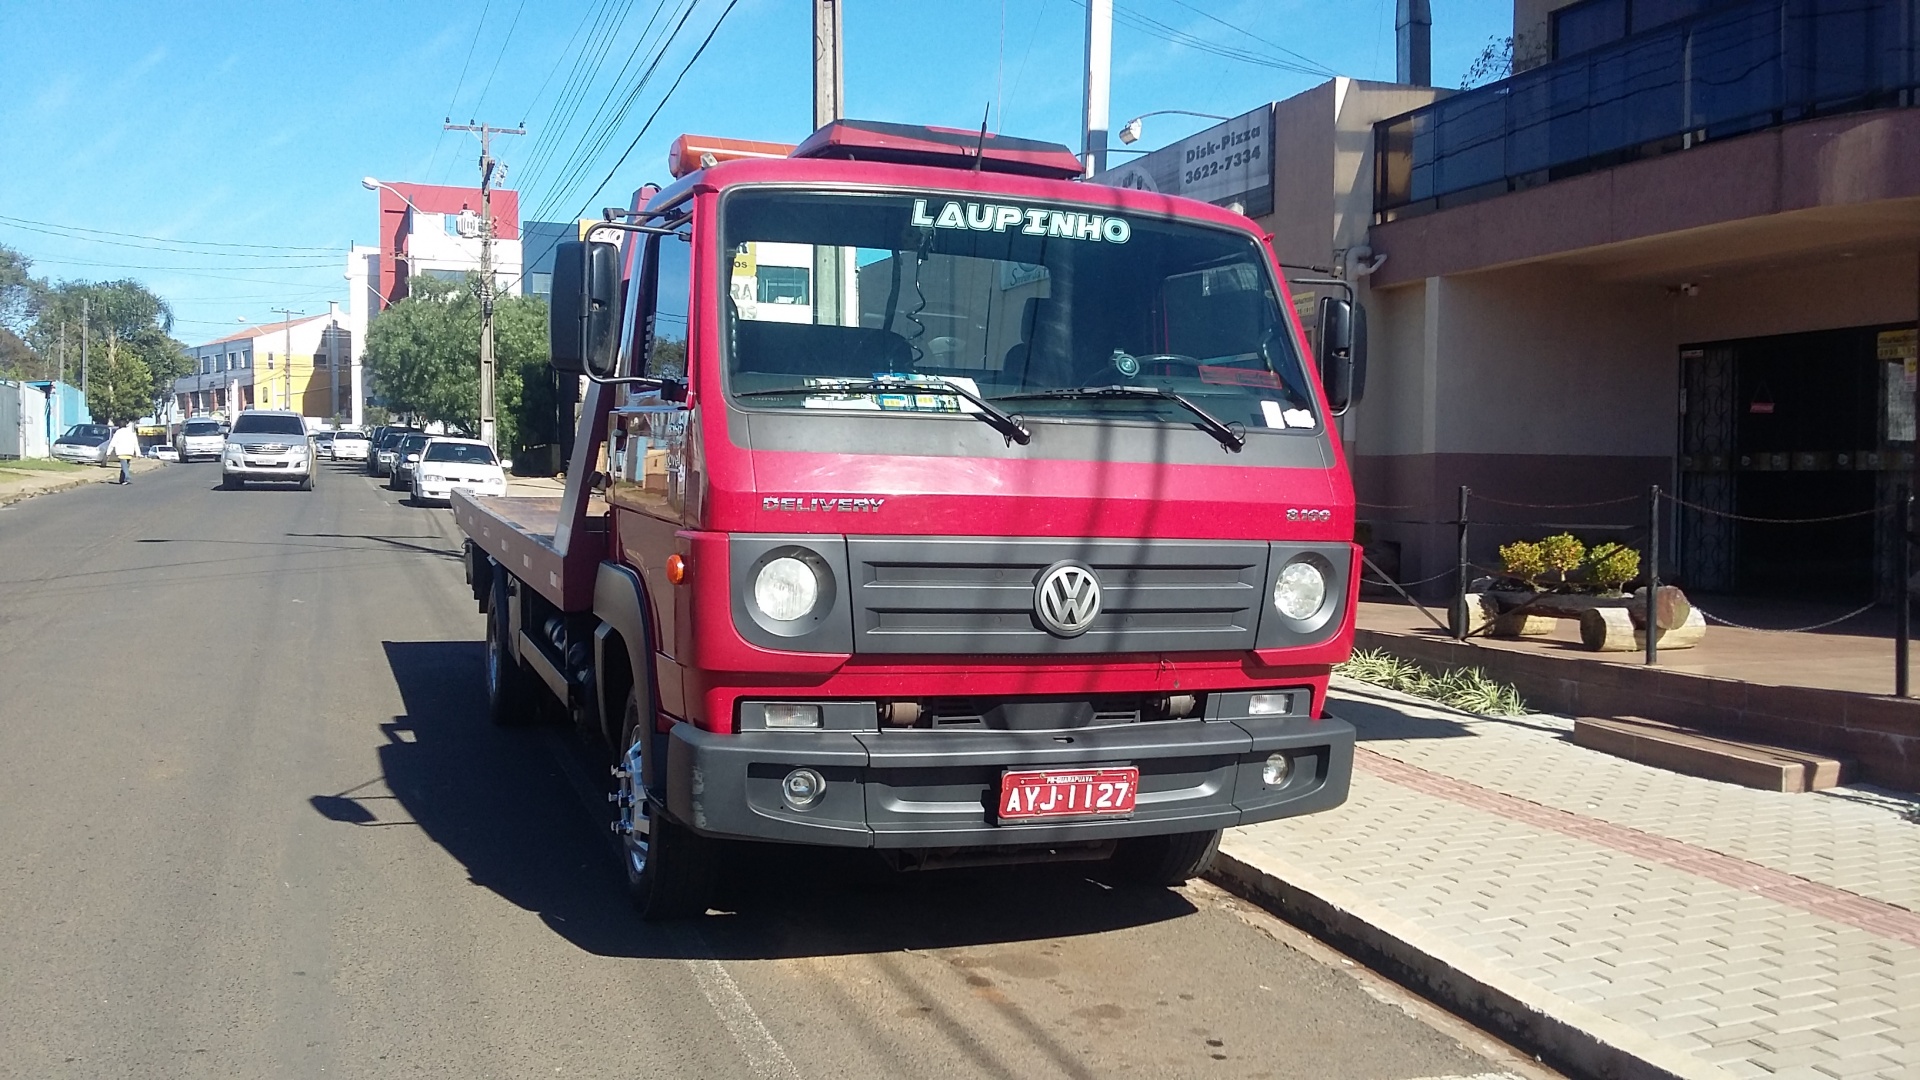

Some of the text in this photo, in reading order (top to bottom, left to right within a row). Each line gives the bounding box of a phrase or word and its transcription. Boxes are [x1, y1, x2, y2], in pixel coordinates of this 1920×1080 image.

[1185, 125, 1261, 164] Disk-Pizza
[1185, 145, 1261, 185] 3622-7334
[911, 199, 1131, 244] LAUPINHO
[762, 497, 885, 512] DELIVERY
